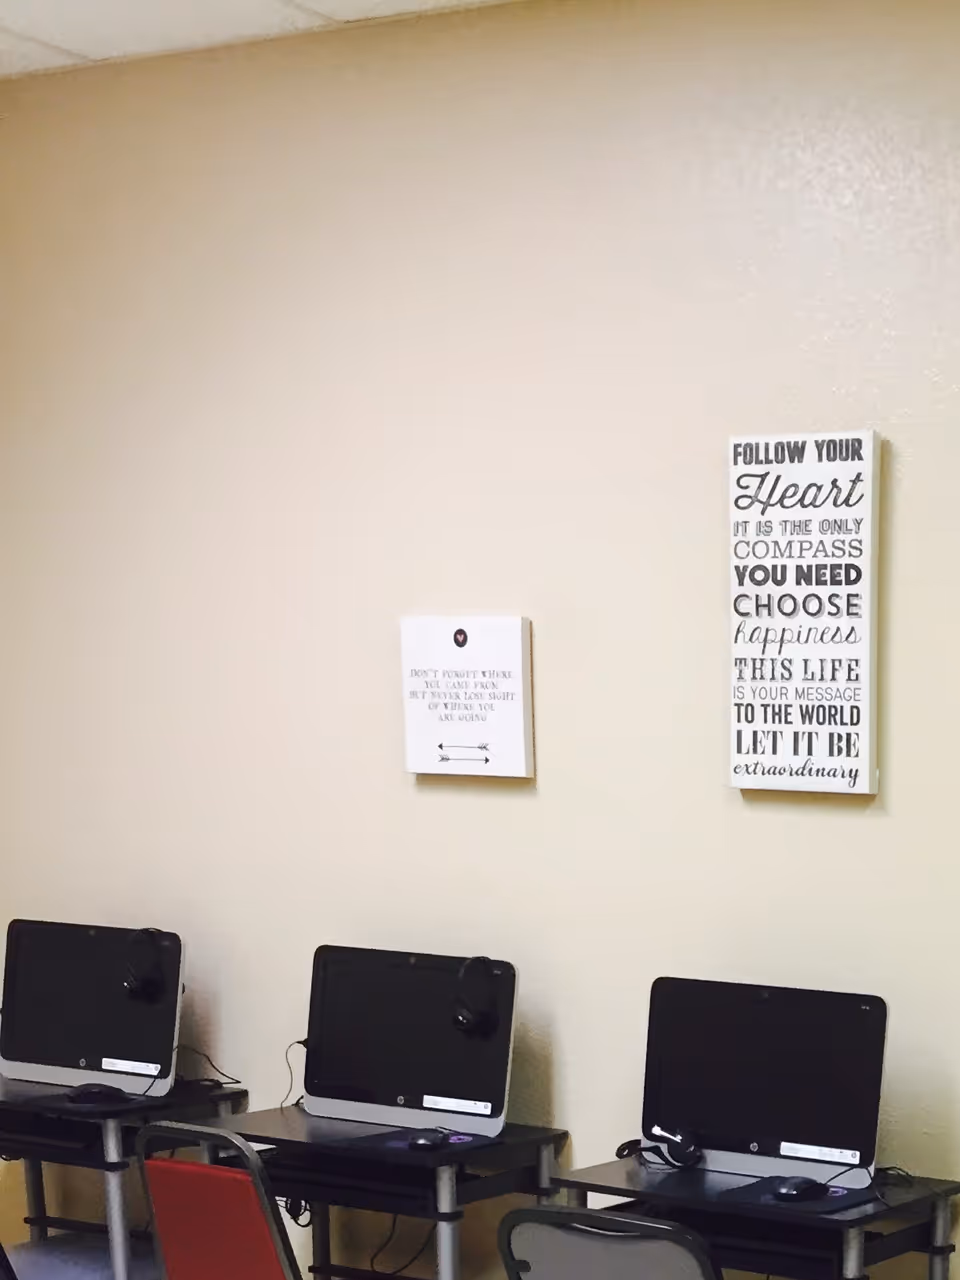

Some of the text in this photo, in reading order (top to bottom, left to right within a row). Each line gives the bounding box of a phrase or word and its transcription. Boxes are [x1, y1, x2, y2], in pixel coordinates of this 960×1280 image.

[733, 438, 864, 466] FOLLOW YOUR
[733, 471, 864, 516] Heart
[733, 518, 864, 537] IT IS THE ONLY
[733, 538, 863, 560] COMPASS
[734, 563, 862, 587] YOU NEED
[733, 593, 862, 619] CHOOSE
[733, 620, 862, 655] happiness
[735, 657, 861, 683] THIS LIFE
[733, 685, 861, 702] IS YOUR MESSAGE
[734, 703, 861, 727] TO THE WORLD
[736, 729, 860, 758] LET IT BE
[733, 757, 860, 788] extraordinary
